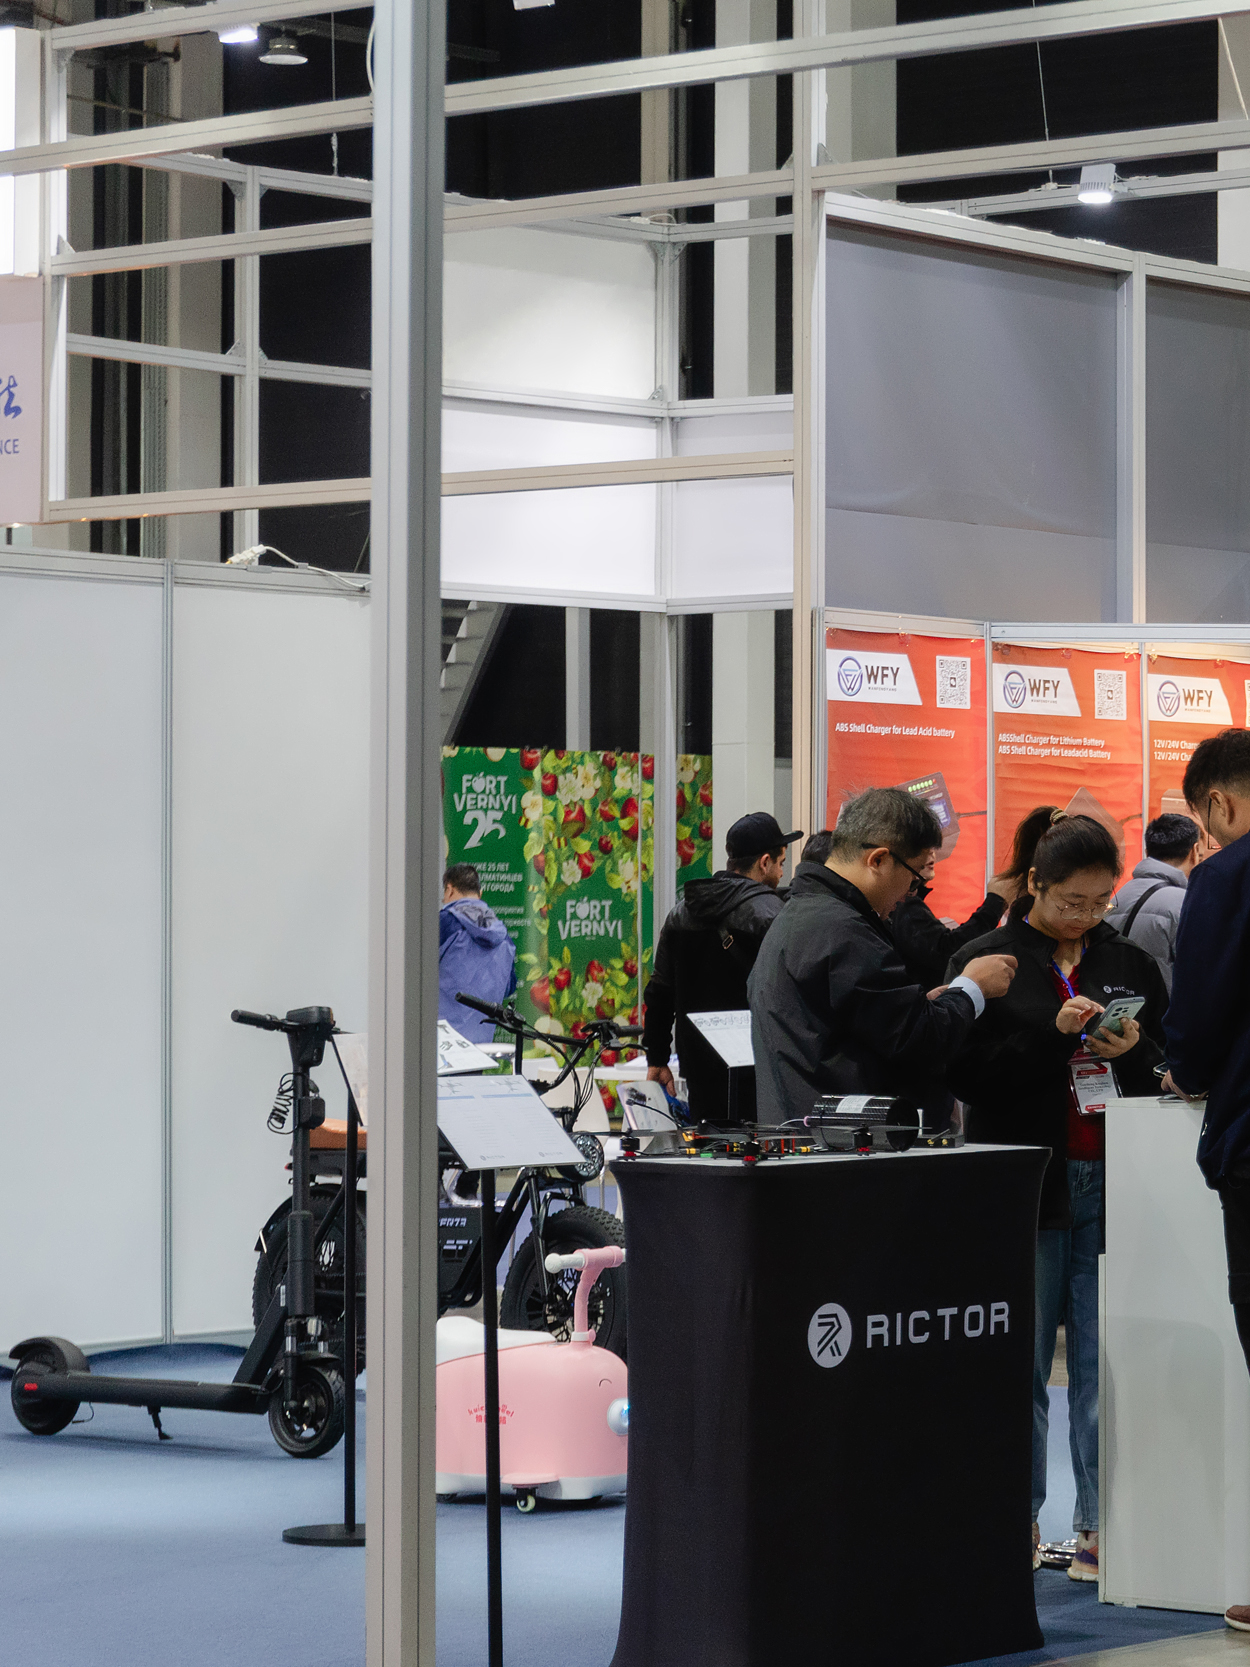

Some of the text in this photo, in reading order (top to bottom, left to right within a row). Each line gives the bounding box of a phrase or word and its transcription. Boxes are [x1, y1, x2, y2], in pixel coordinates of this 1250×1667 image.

[865, 664, 900, 686] WFY
[1028, 678, 1060, 698] WFY
[1182, 688, 1213, 708] WFY
[835, 722, 955, 739] ABS Shell Charger for Lead Acid battery
[1025, 734, 1050, 746] Charger
[1050, 735, 1059, 745] for
[1060, 736, 1083, 746] Lithium
[1083, 737, 1105, 748] Battery
[1154, 739, 1180, 750] 12V/24V
[998, 745, 1111, 760] ABS Shell Charger for Leadacid Battery
[1154, 751, 1192, 761] 12V/24V Cha
[453, 792, 517, 814] VERNYI
[463, 809, 506, 850] 25
[557, 919, 623, 940] VERNYI
[1112, 986, 1135, 996] RICOR
[866, 1301, 1009, 1348] RICTOR
